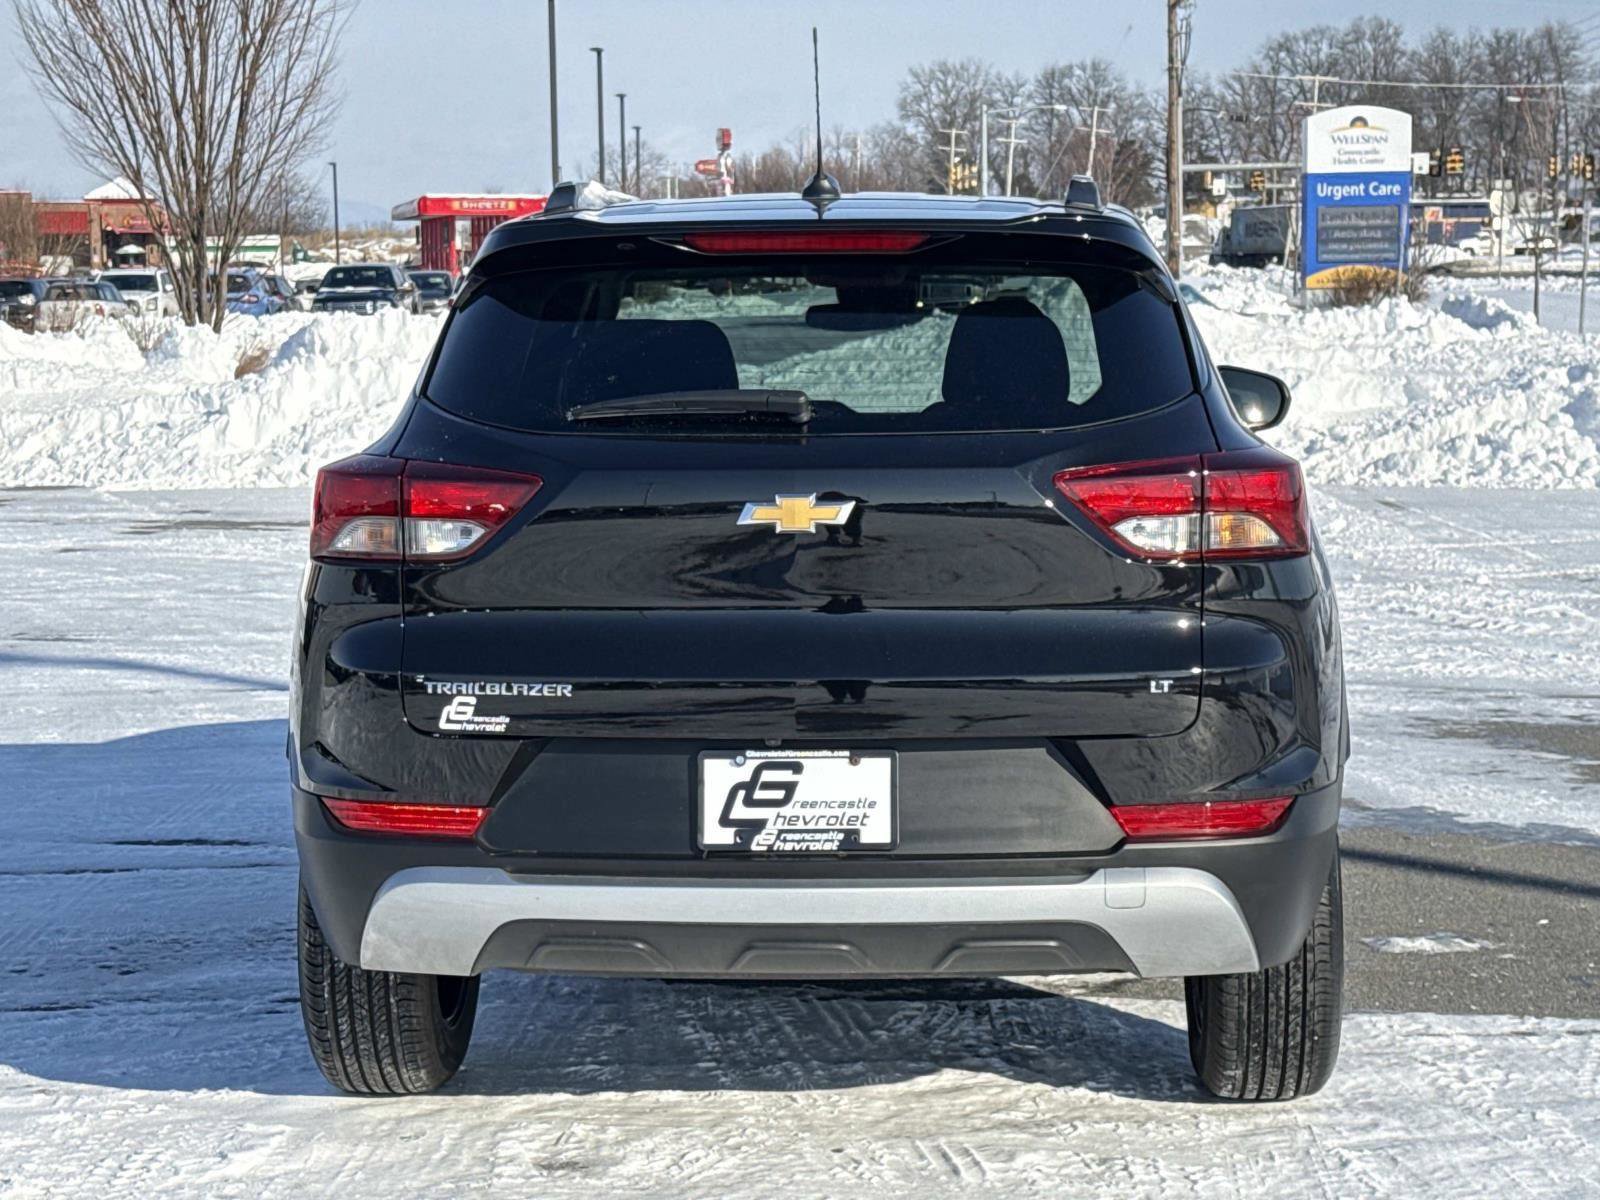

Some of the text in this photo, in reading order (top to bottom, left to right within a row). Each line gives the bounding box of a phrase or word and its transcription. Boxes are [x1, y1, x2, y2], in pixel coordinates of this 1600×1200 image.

[1333, 157, 1385, 165] Health Center
[1316, 181, 1402, 200] Urgent Care
[461, 200, 507, 209] SHEETZ
[424, 681, 573, 697] TRAILBLAZER
[1150, 680, 1173, 693] LT
